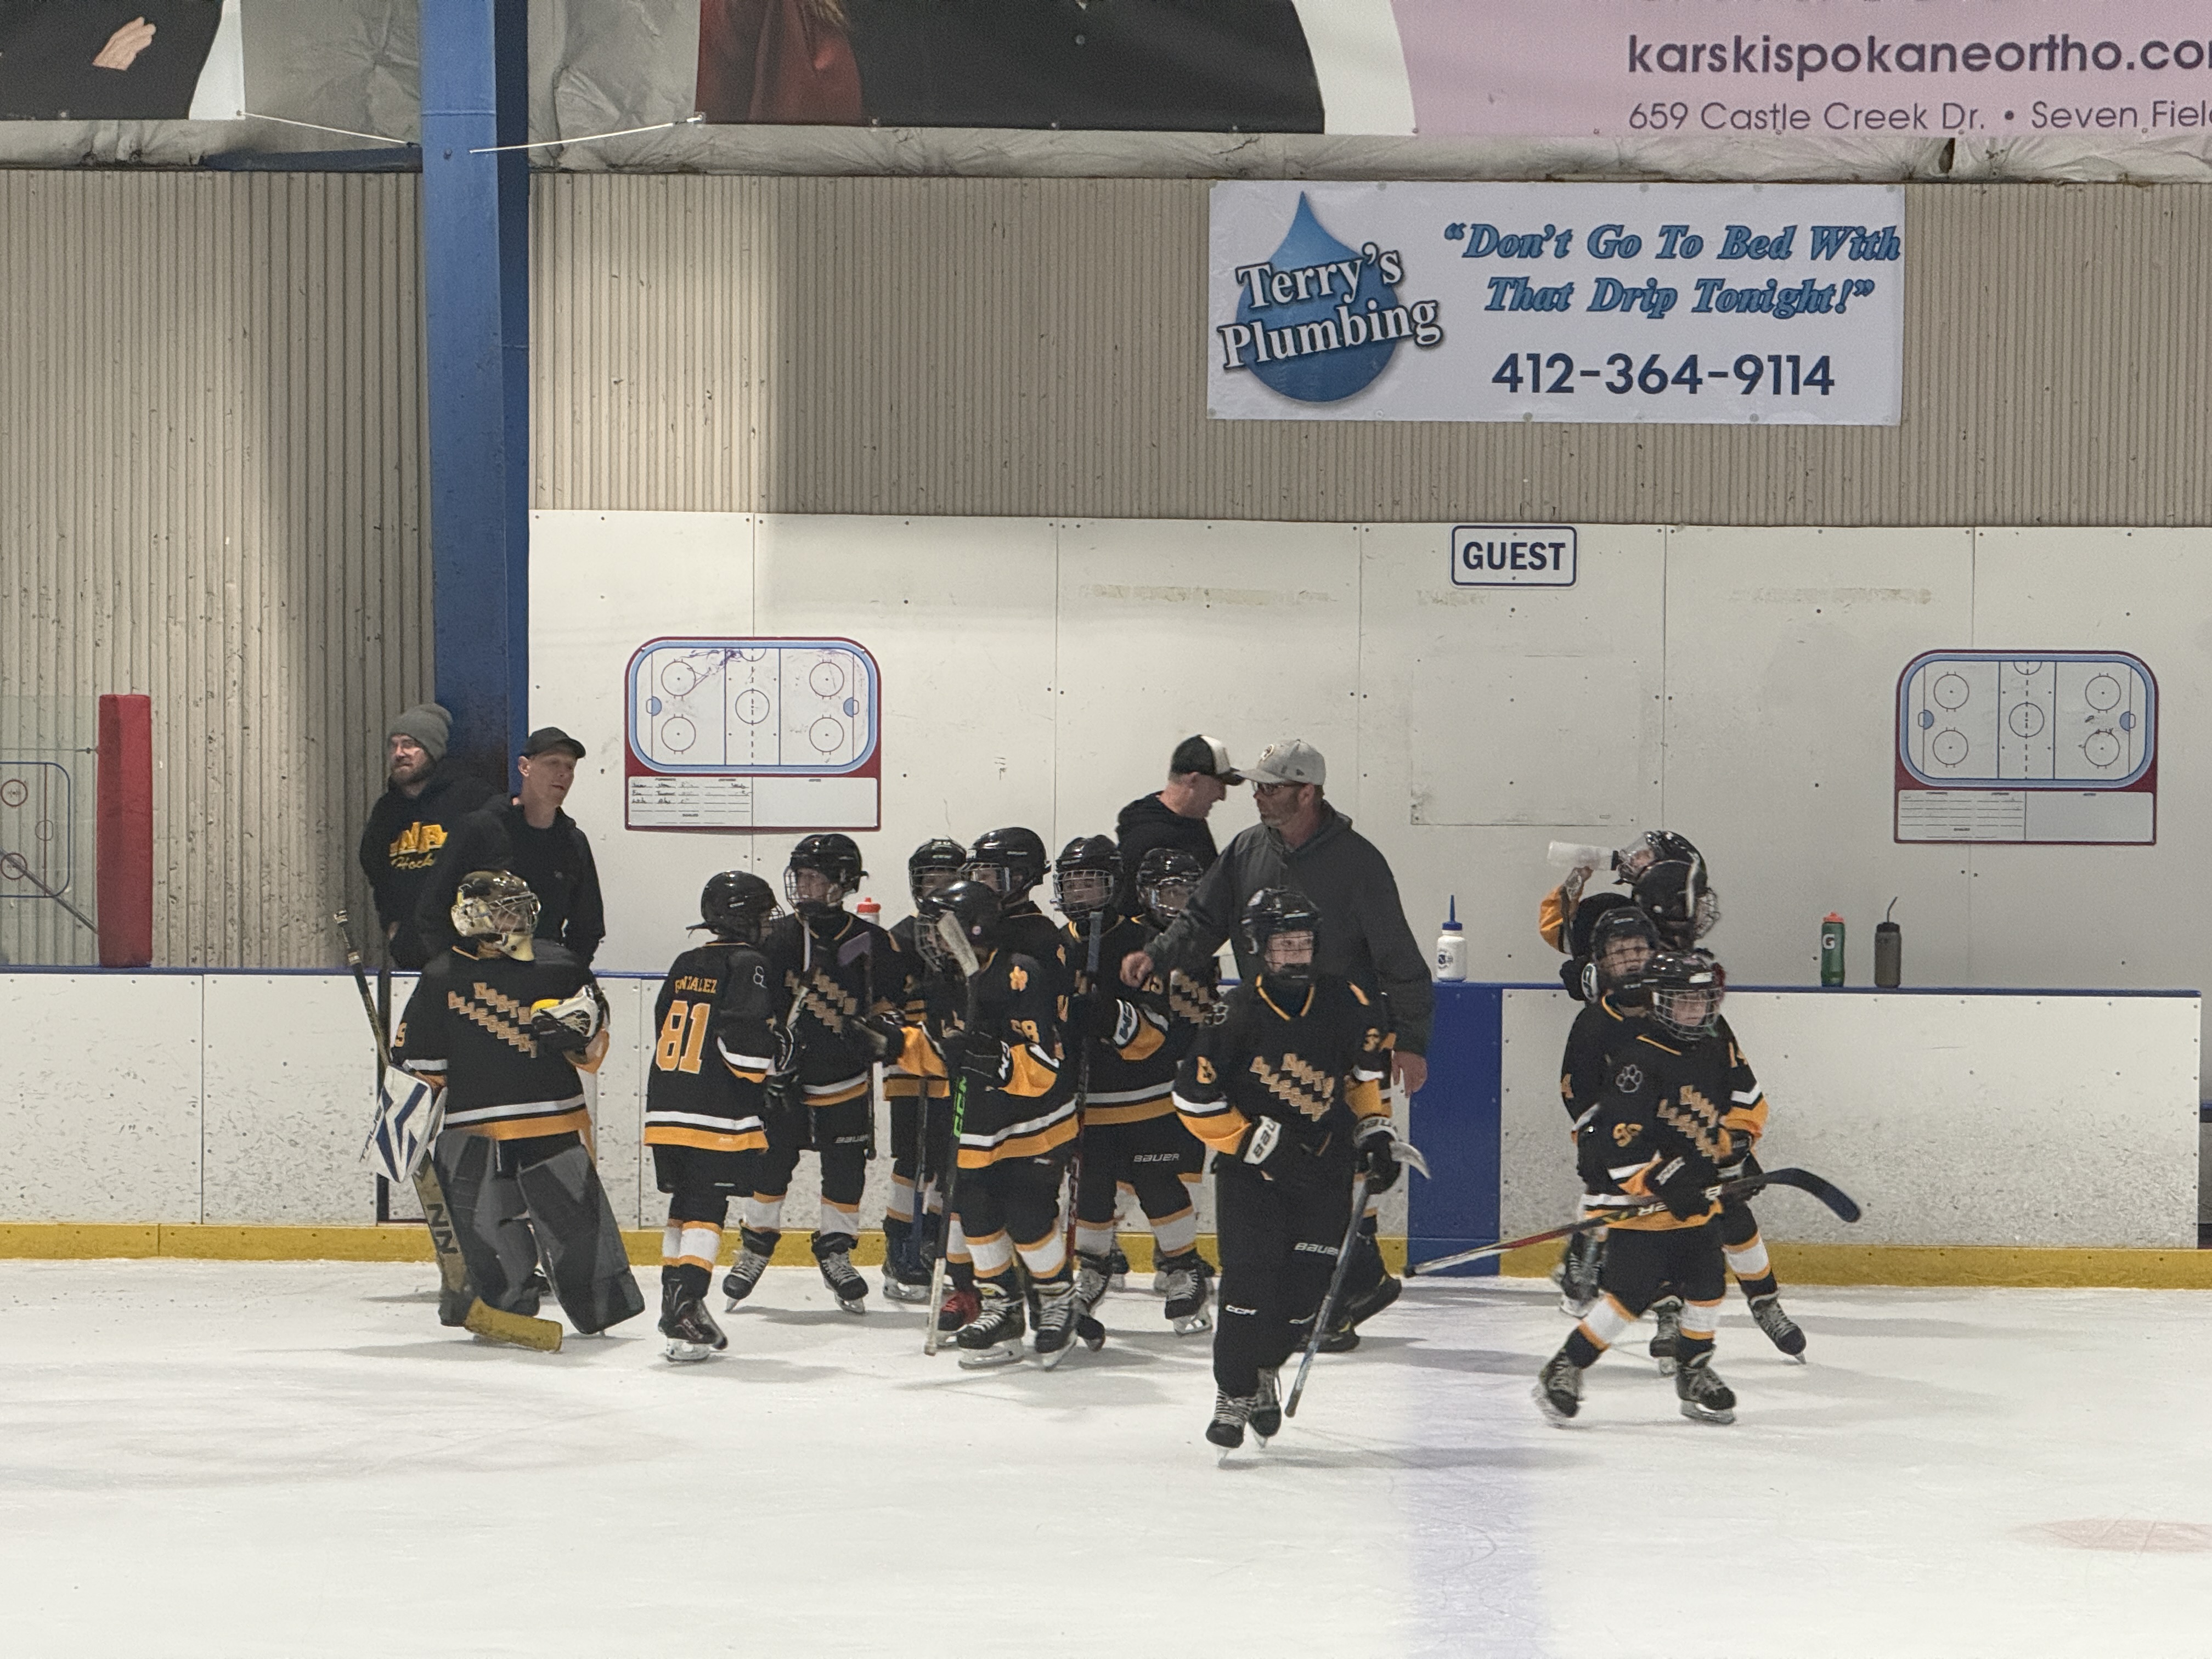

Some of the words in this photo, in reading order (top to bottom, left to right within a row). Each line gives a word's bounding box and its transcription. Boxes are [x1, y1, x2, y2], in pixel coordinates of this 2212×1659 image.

[1629, 33, 2212, 82] karskispokaneortho.co
[1629, 102, 1689, 130] 659
[1701, 102, 1811, 130] Castle
[1824, 102, 1928, 130] Creek
[1942, 102, 1985, 129] Dr.
[2032, 101, 2138, 129] Seven
[2152, 100, 2212, 127] Fiel
[1587, 223, 1643, 259] Go
[1655, 224, 1705, 259] To
[1716, 224, 1799, 261] Bed
[1810, 225, 1901, 262] With
[1235, 241, 1404, 308] Terry’s
[1483, 276, 1575, 313] That
[1585, 277, 1678, 320] Drip
[1217, 300, 1443, 370] Plumbing
[1492, 353, 1835, 396] 412-364-9114
[1463, 541, 1566, 571] GUEST
[1822, 934, 1835, 950] G
[656, 1000, 711, 1075] 81
[1133, 1153, 1180, 1163] BAUER
[1294, 1242, 1339, 1256] BAUE
